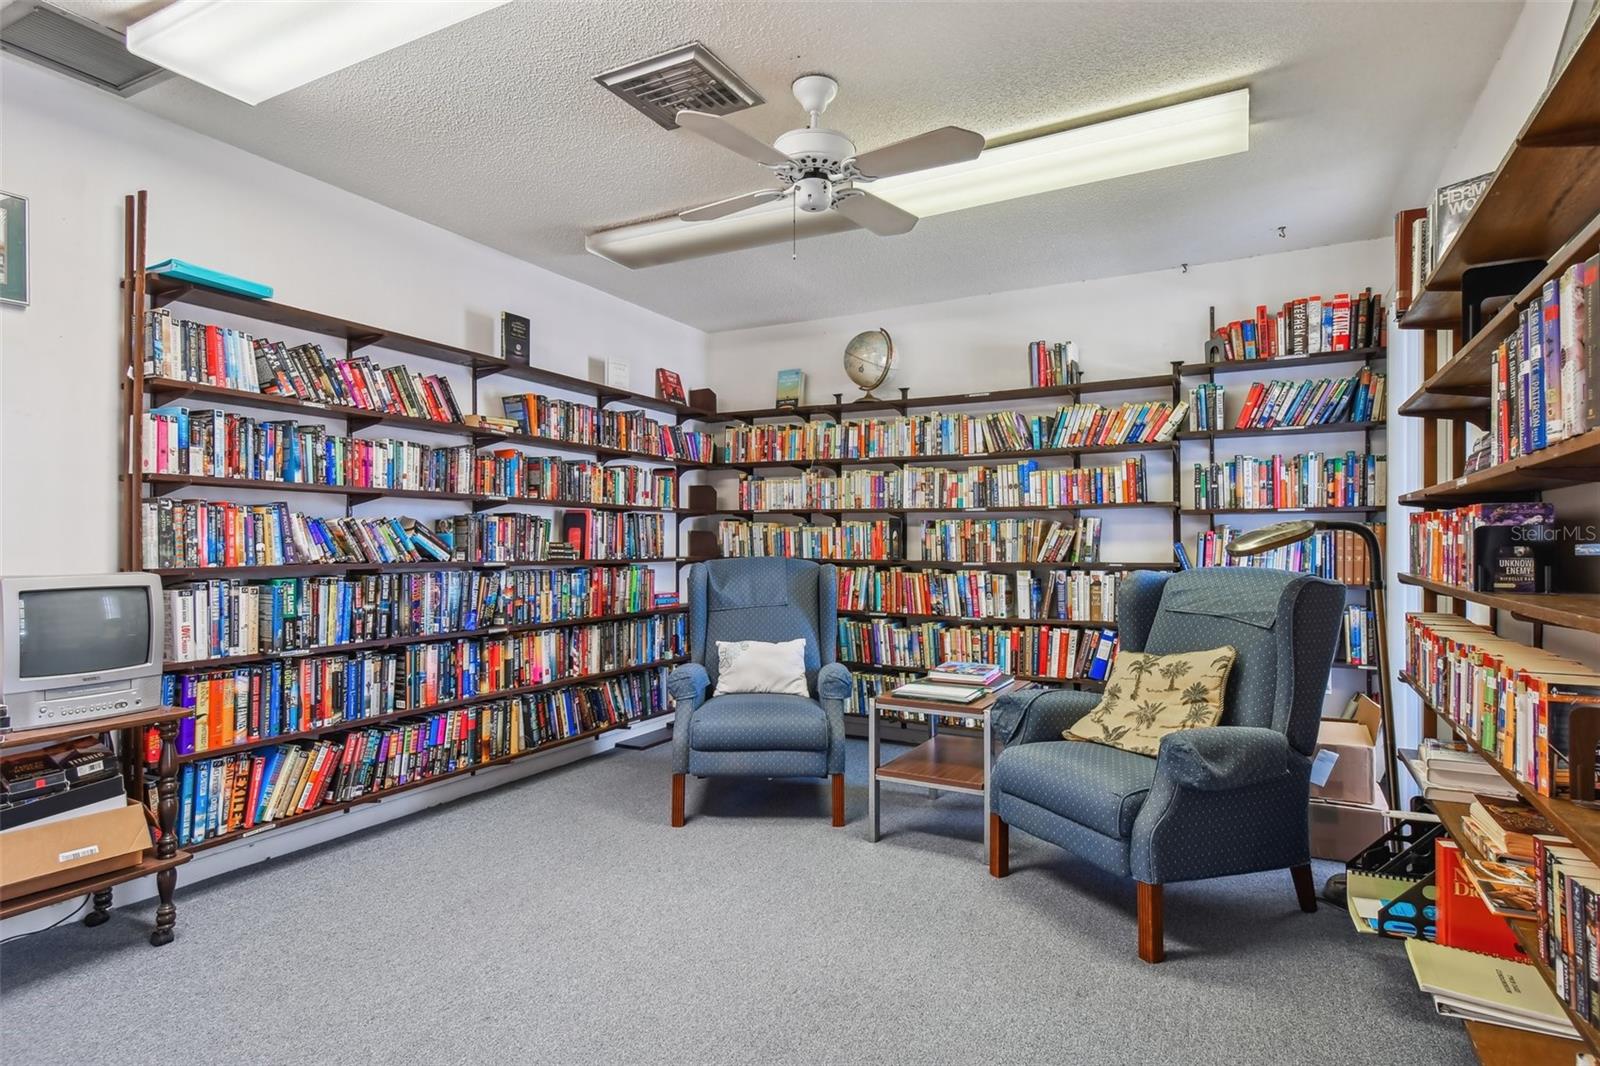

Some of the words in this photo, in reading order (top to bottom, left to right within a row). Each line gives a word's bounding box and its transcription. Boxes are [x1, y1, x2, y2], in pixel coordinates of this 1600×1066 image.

[1440, 181, 1486, 206] HERM
[1449, 197, 1477, 216] WO
[1294, 304, 1306, 336] TEPHEN
[1333, 312, 1350, 336] KING
[1533, 382, 1541, 428] PATTERSON
[181, 625, 191, 640] LOVE
[68, 752, 104, 765] TITANIC
[225, 763, 235, 783] SAIL
[232, 774, 247, 819] EXILE
